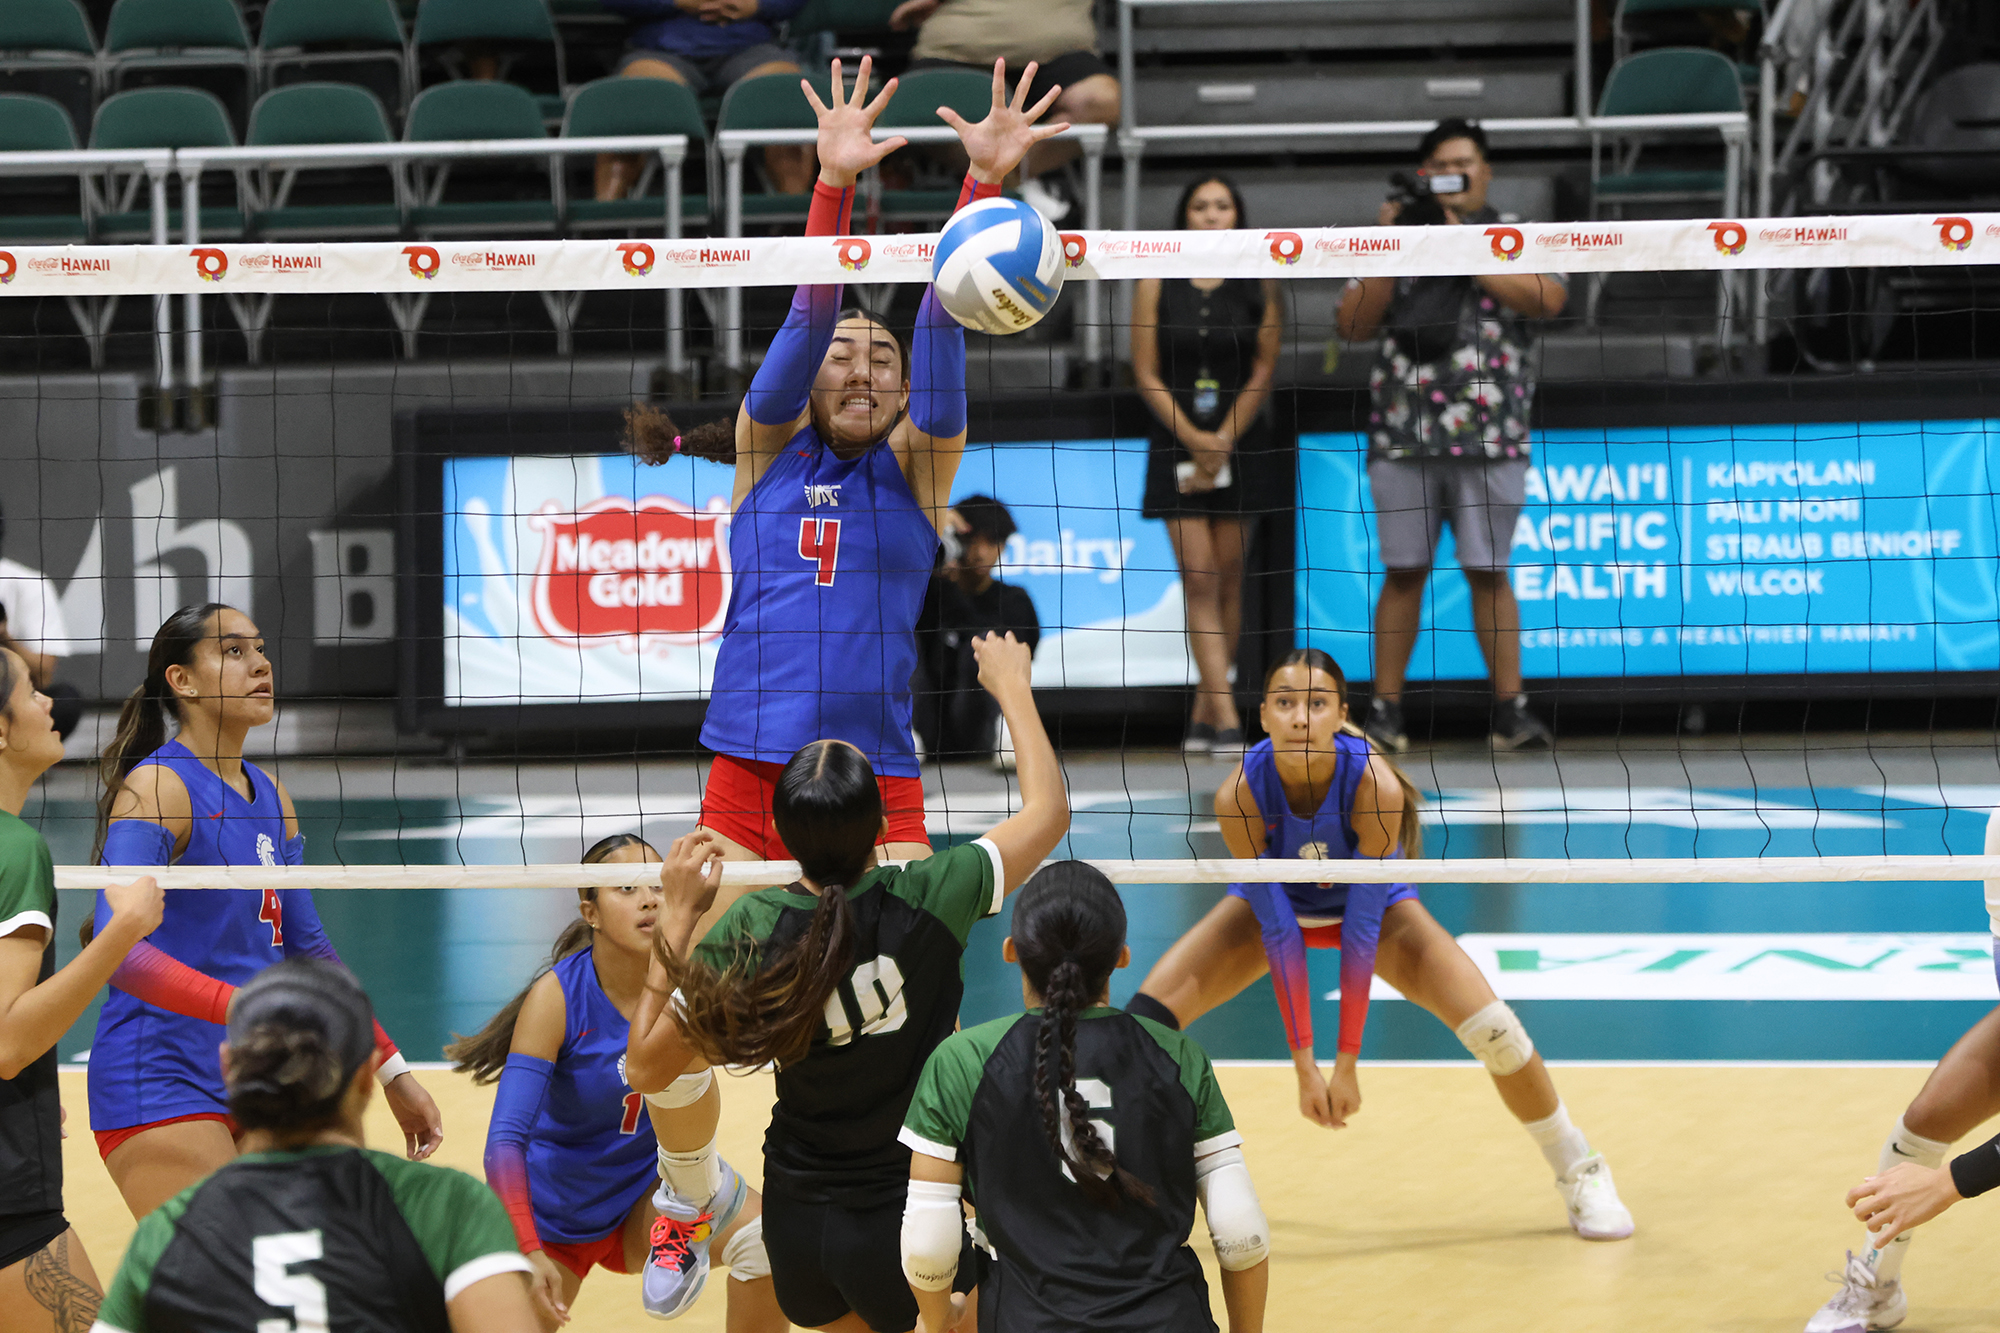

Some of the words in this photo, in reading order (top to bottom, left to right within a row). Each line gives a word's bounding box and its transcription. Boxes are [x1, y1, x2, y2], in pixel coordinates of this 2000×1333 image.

[1131, 240, 1181, 254] HAWAII
[1349, 238, 1400, 252] HAWAII
[1570, 233, 1623, 247] HAWAII
[1794, 227, 1847, 242] HAWAII
[61, 257, 110, 271] HAWAII
[272, 255, 321, 269] HAWAII
[485, 252, 535, 266] HAWAII
[700, 249, 750, 262] HAWAII
[1707, 497, 1771, 524] PALI
[1779, 496, 1860, 523] MOMI
[1511, 511, 1667, 552] ACIFIC
[1706, 533, 1823, 560] STRAUB
[1831, 529, 1961, 559] BENIOFF
[556, 531, 714, 572] Meadow
[798, 517, 841, 588] 4
[588, 570, 685, 608] Gold
[1514, 561, 1667, 600] EALTH
[1706, 568, 1824, 596] WILCOX
[252, 1228, 330, 1333] 5
